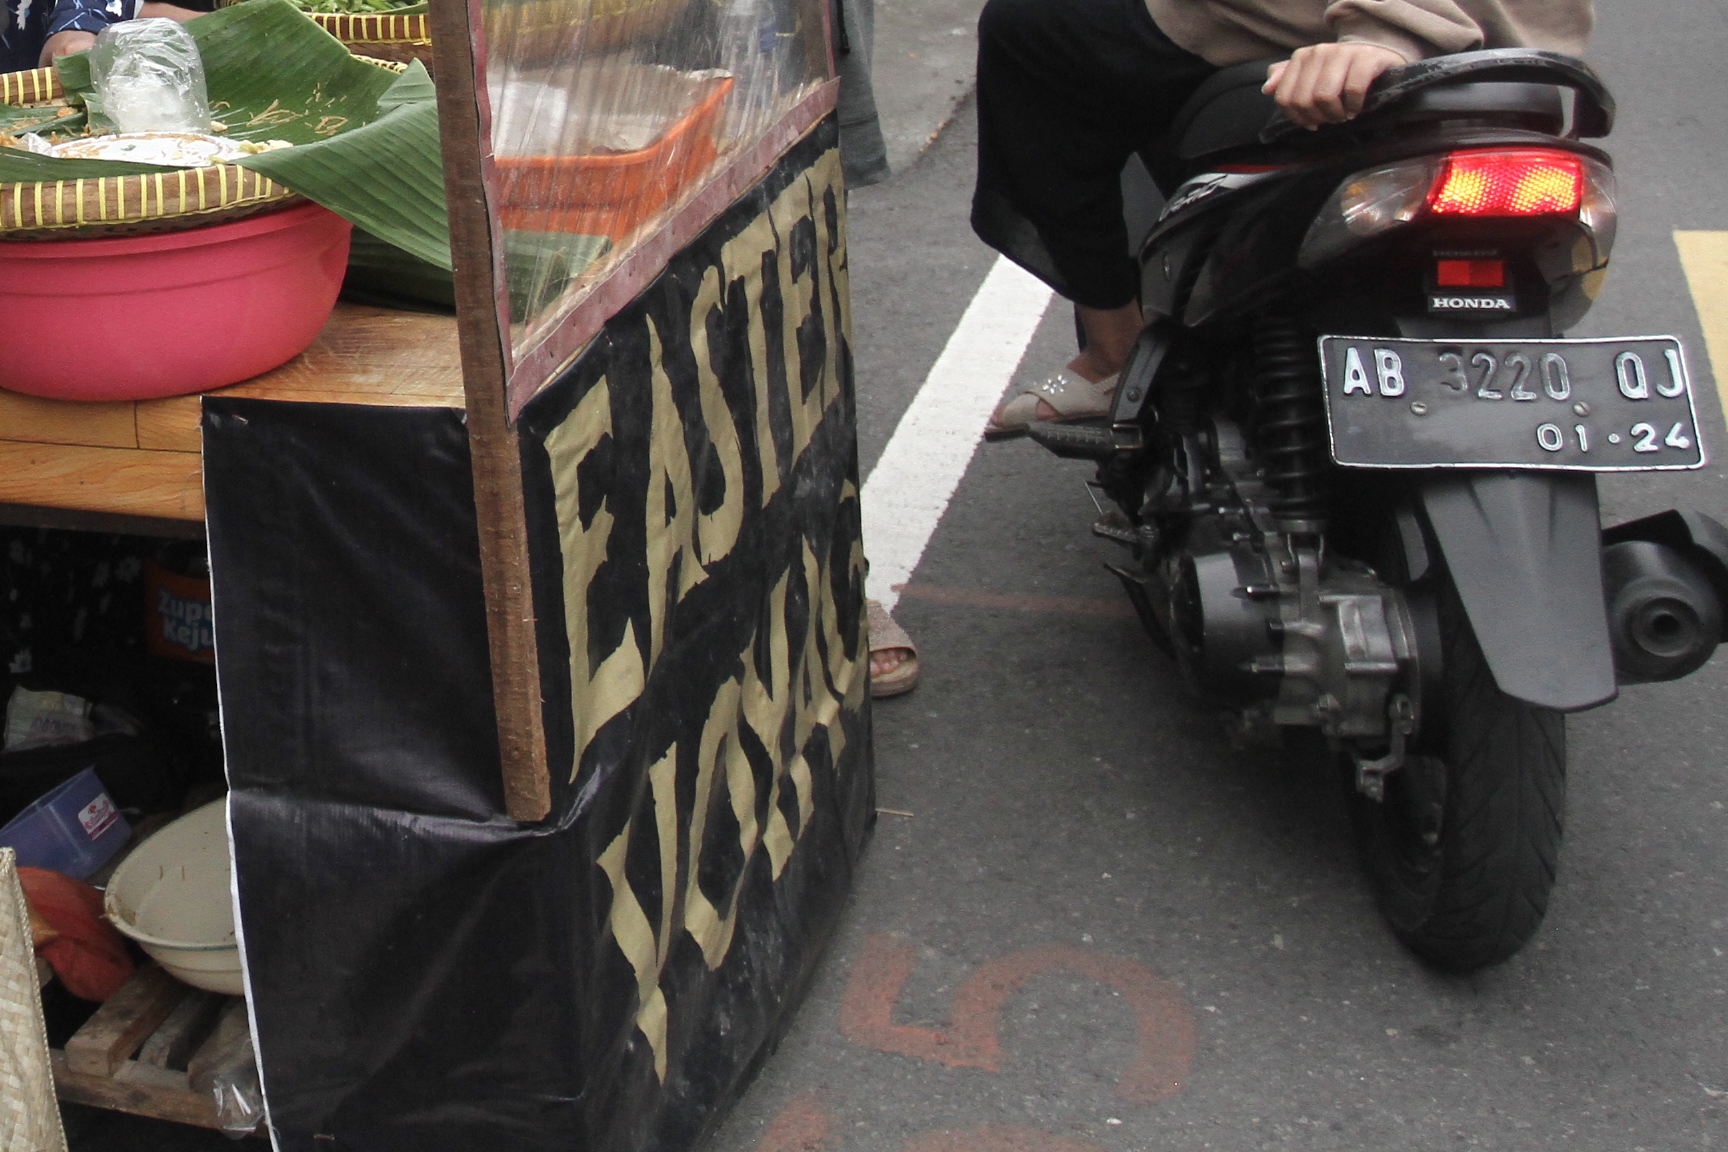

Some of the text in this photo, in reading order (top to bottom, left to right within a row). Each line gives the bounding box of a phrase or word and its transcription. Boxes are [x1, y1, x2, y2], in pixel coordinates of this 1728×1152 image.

[1432, 297, 1511, 309] HONDA
[1343, 347, 1405, 397] AB
[1438, 351, 1570, 401] 3220
